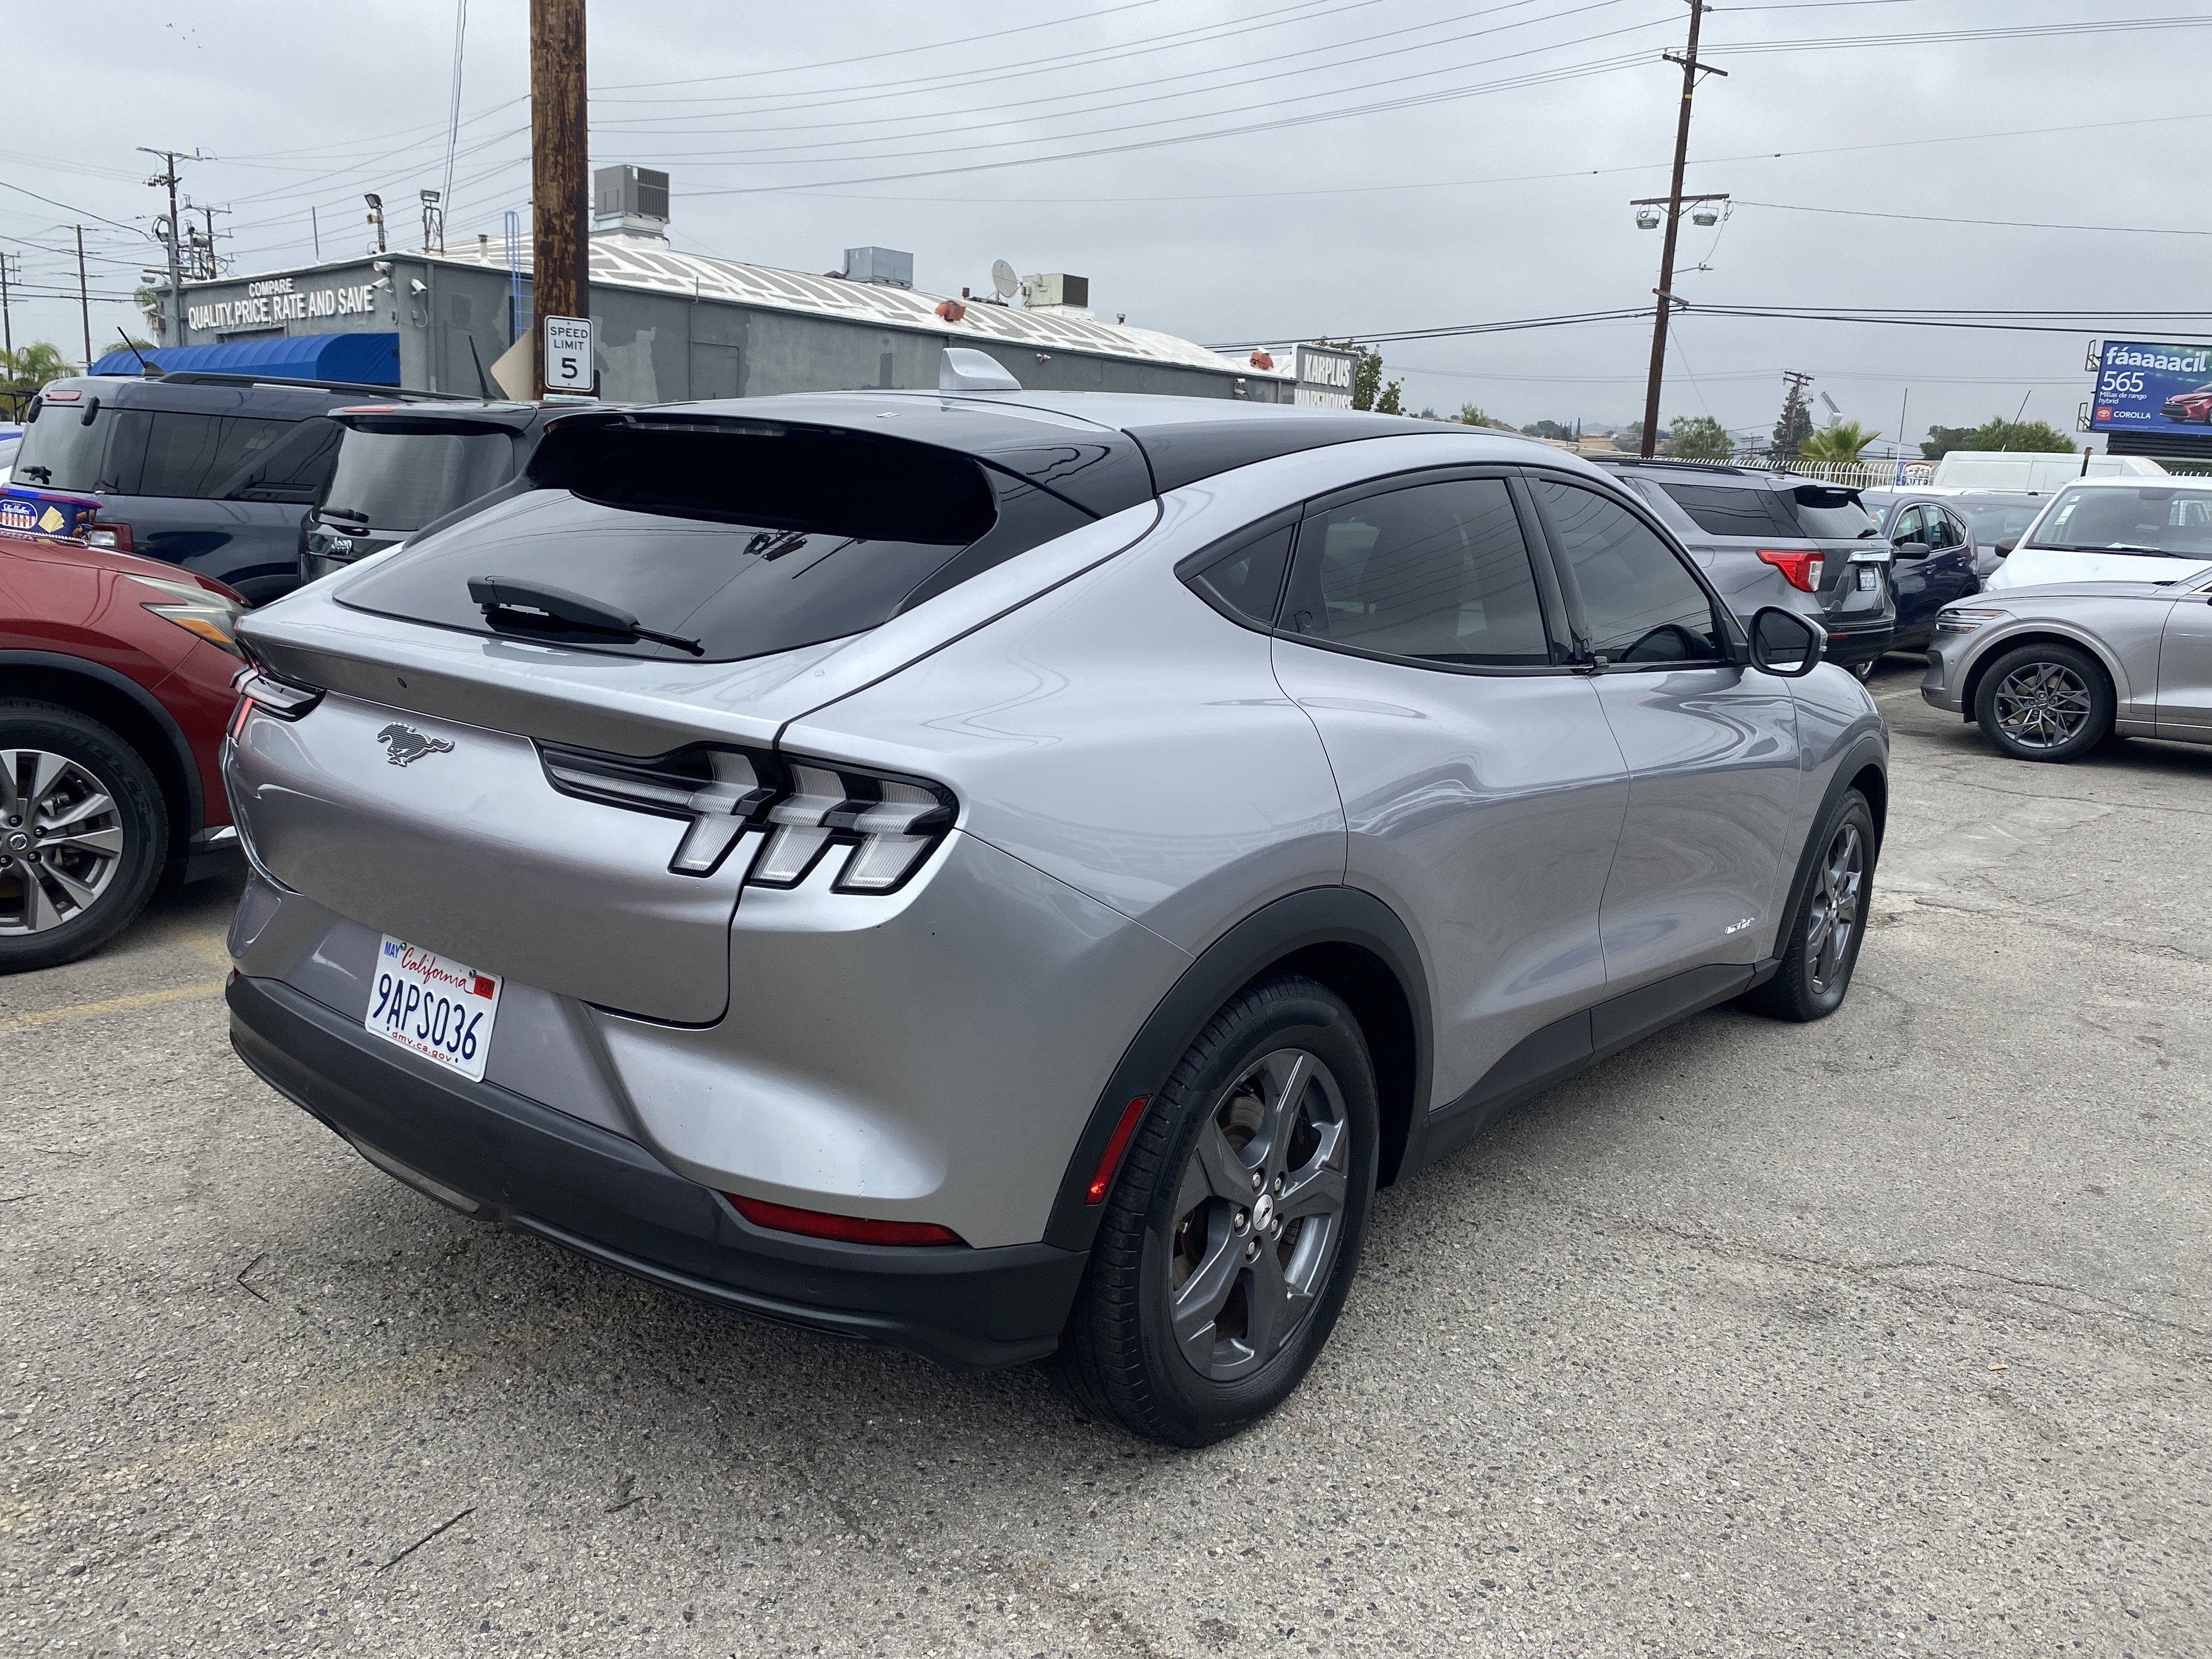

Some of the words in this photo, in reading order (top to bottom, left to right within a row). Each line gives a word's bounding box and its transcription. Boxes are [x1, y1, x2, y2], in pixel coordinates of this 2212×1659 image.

[249, 278, 294, 297] COMPARE
[274, 293, 307, 320] RATE
[309, 290, 336, 317] AND
[338, 285, 375, 315] SAVE
[550, 326, 588, 338] SPEED
[554, 339, 584, 351] LIMIT
[561, 357, 578, 379] 5
[1304, 354, 1351, 388] KARPLUS
[2101, 371, 2145, 392] 565
[2113, 411, 2151, 419] COROLLA
[384, 941, 400, 959] MAY
[402, 947, 473, 994] California
[373, 973, 484, 1060] 9APS036
[392, 1031, 452, 1062] dmv.ca.gov
